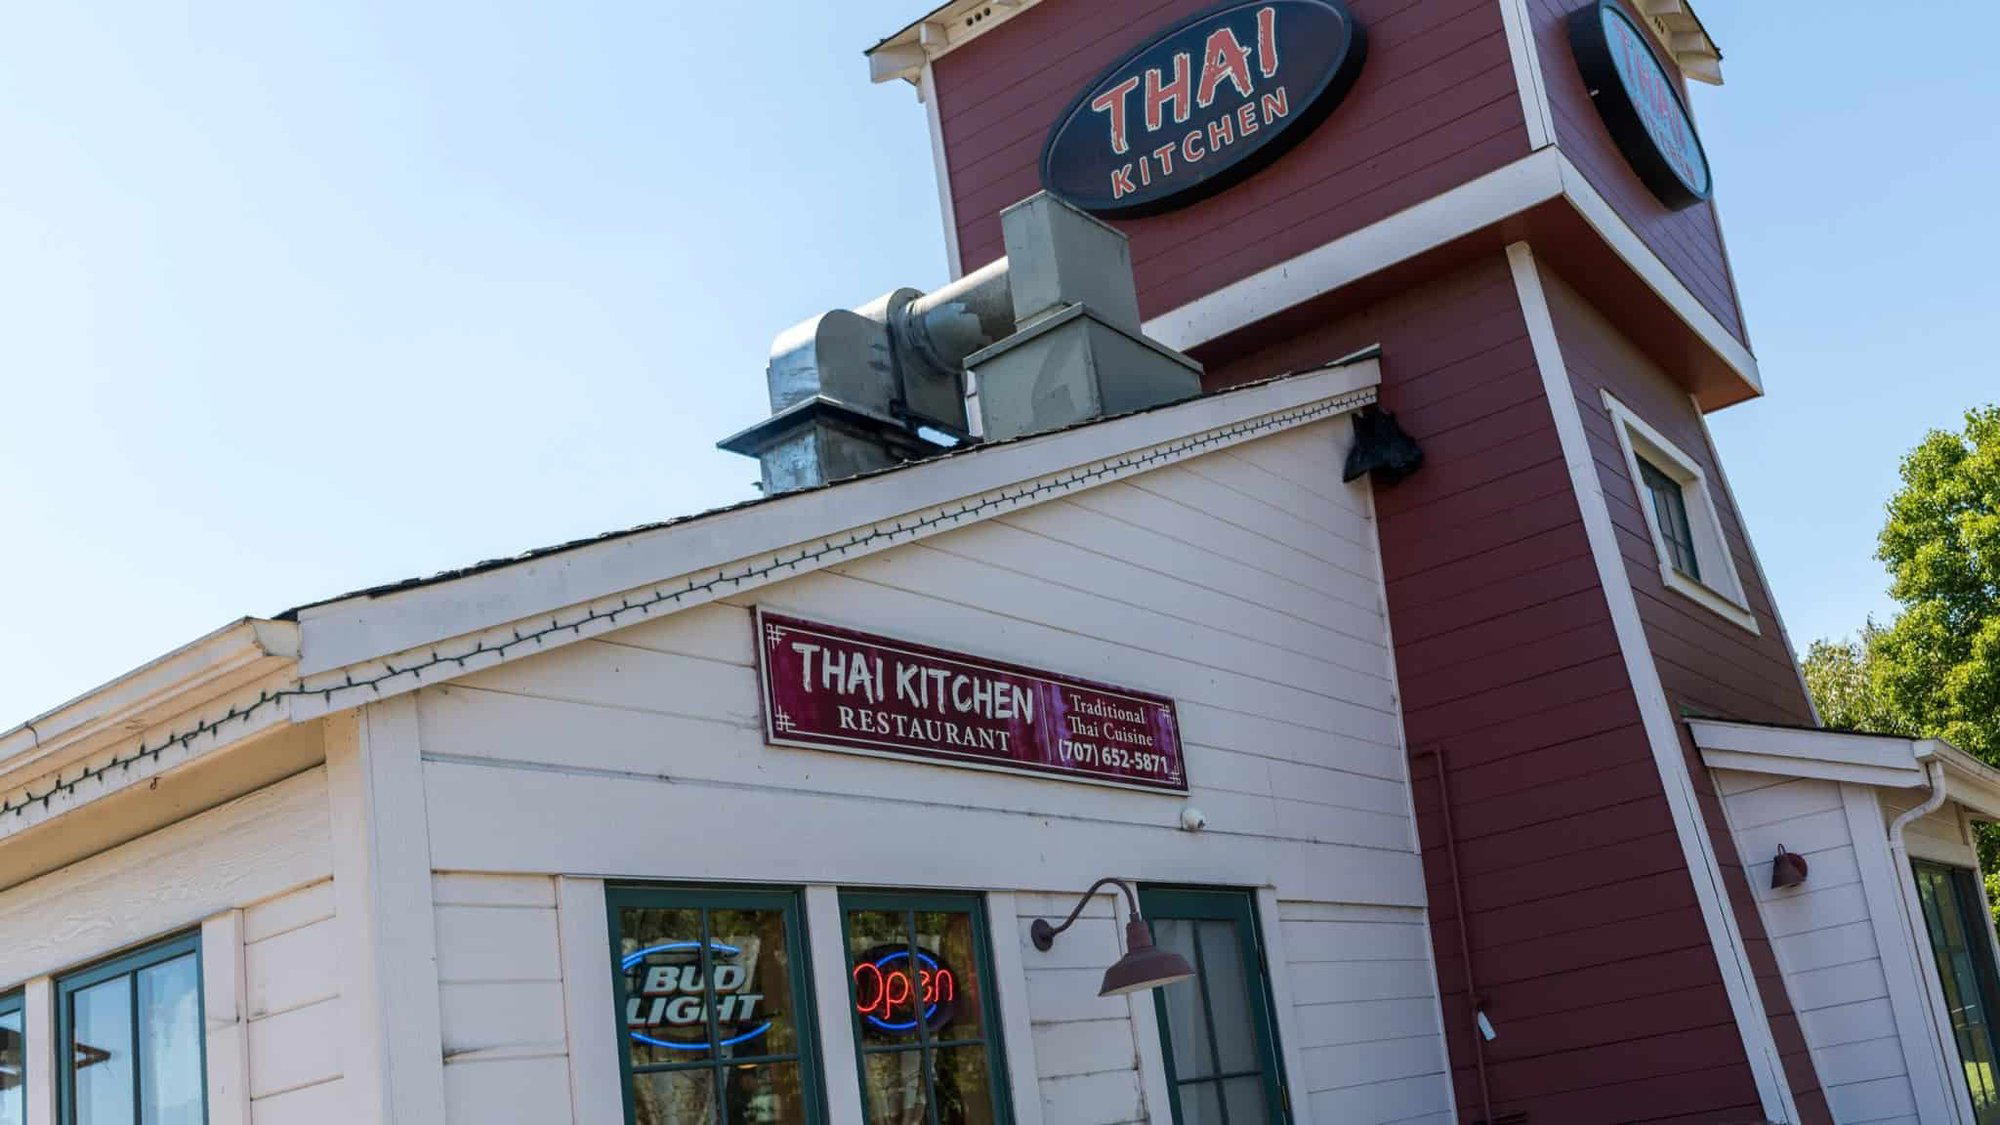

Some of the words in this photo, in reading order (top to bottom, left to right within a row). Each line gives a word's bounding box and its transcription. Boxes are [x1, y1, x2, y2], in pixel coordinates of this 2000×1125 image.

[1092, 7, 1279, 155] THAI
[1111, 86, 1289, 199] KITCHEN
[791, 642, 884, 705] THAI
[896, 661, 1034, 725] KITCHEN
[1069, 693, 1146, 725] Traditional
[837, 705, 1010, 752] RESTAURANT
[1067, 715, 1099, 738] Thai
[1103, 721, 1154, 747] Cuisine
[1058, 738, 1100, 767] (707)
[1102, 746, 1169, 775] 652-5871
[643, 964, 747, 993] BUD
[625, 994, 764, 1025] LIGHT
